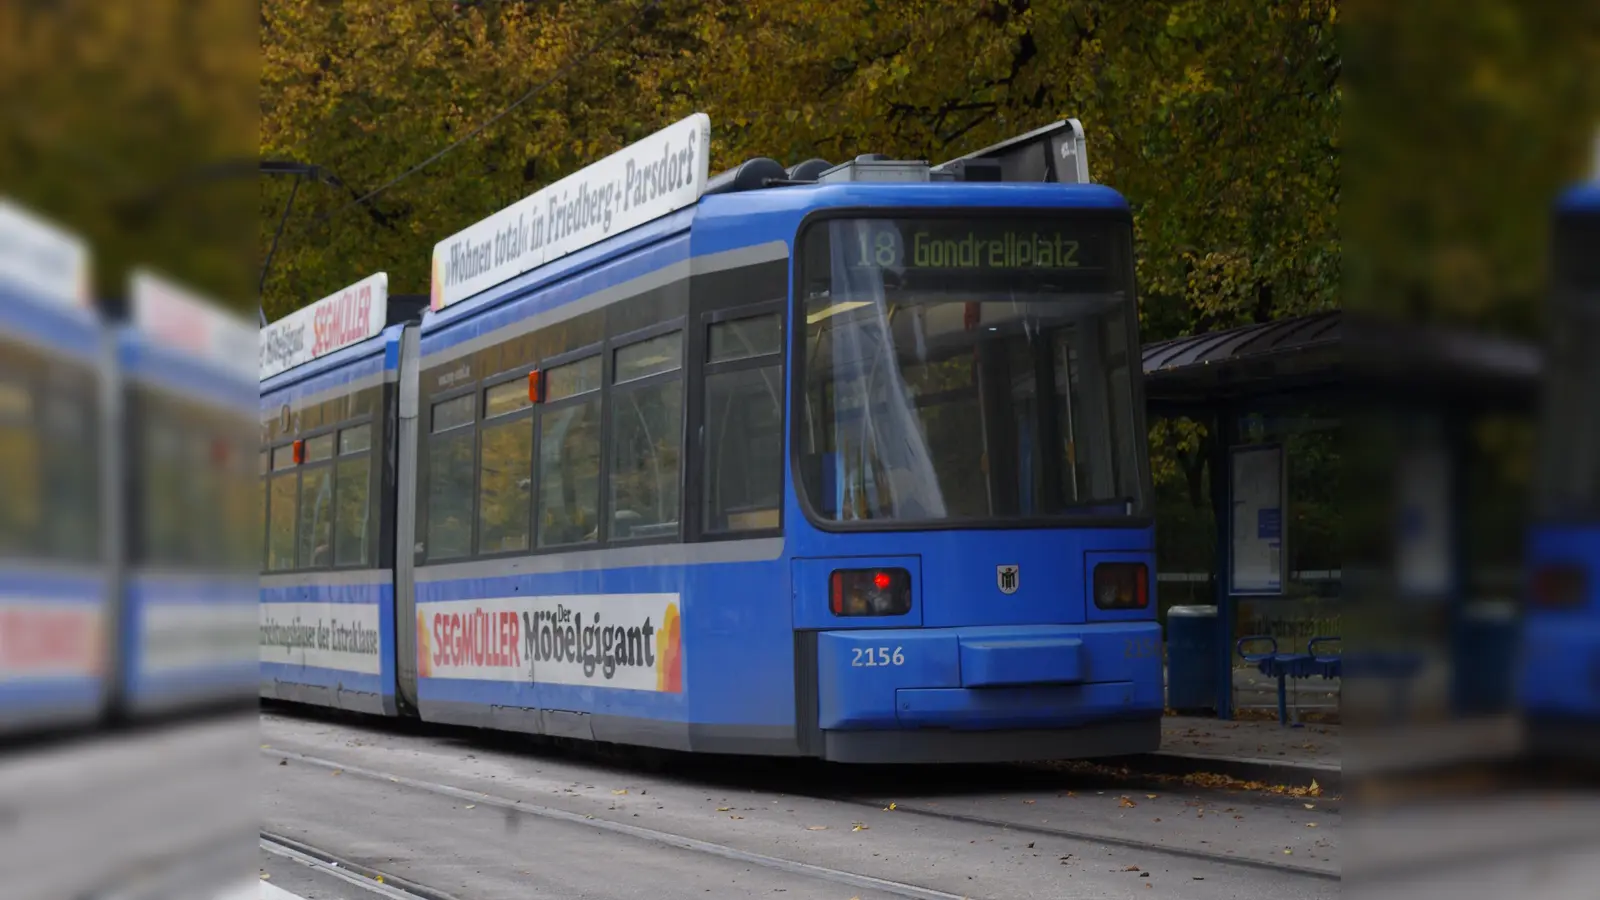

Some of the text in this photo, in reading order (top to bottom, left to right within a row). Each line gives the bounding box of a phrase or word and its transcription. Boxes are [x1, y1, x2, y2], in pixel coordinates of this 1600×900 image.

[530, 205, 544, 252] in
[857, 231, 1079, 267] 18 Gondrellplatz
[312, 285, 372, 356] SEGMÜLLER
[557, 603, 571, 623] Der
[318, 617, 330, 651] der
[433, 607, 655, 679] SEGMÜLLER Möbelgigant
[851, 646, 905, 667] 2156
